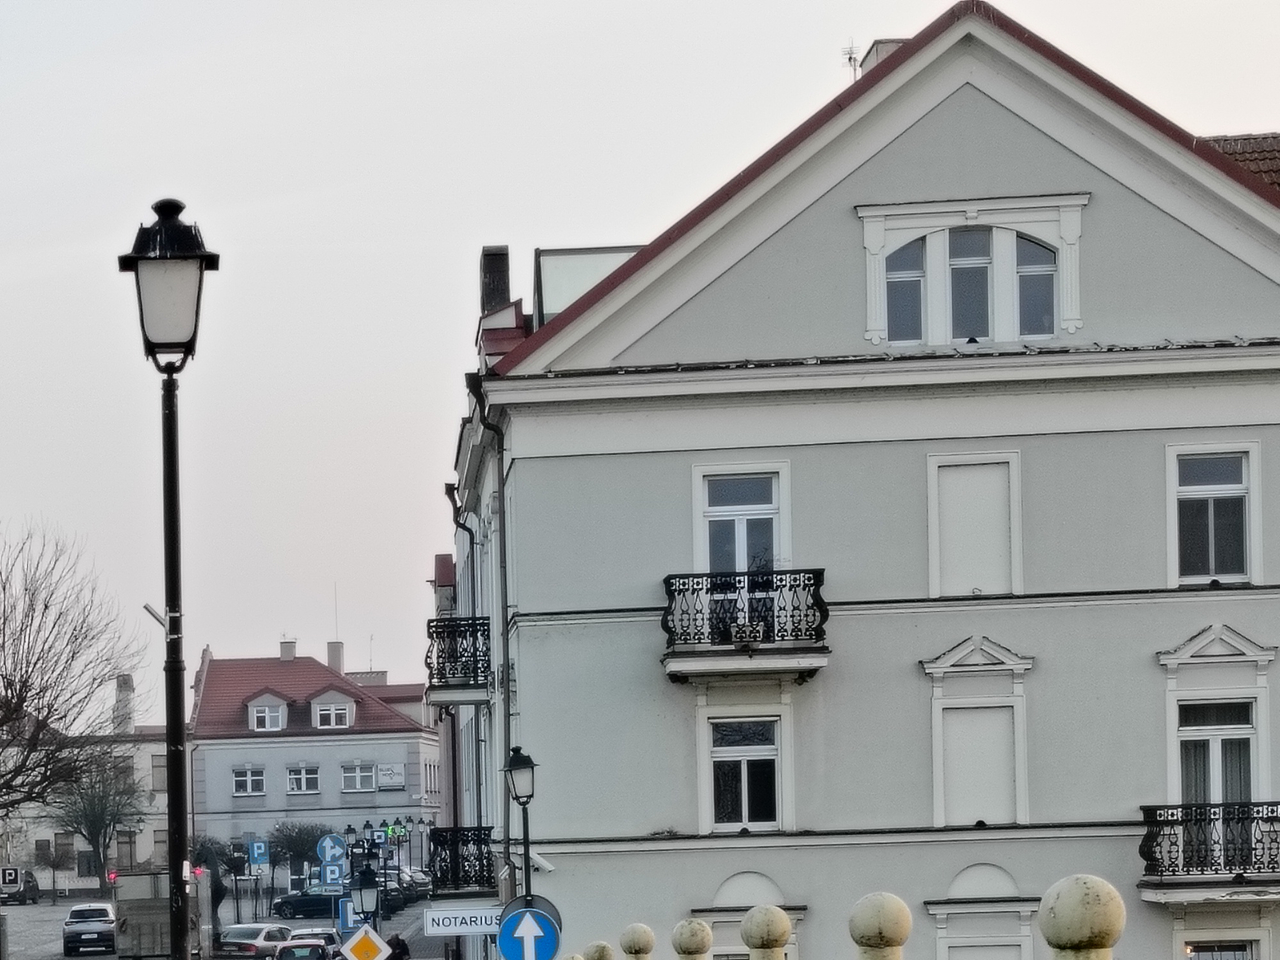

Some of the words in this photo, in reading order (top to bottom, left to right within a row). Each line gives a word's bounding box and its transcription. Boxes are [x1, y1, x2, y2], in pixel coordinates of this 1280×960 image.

[253, 842, 265, 858] P
[5, 869, 15, 883] P
[326, 865, 340, 884] P
